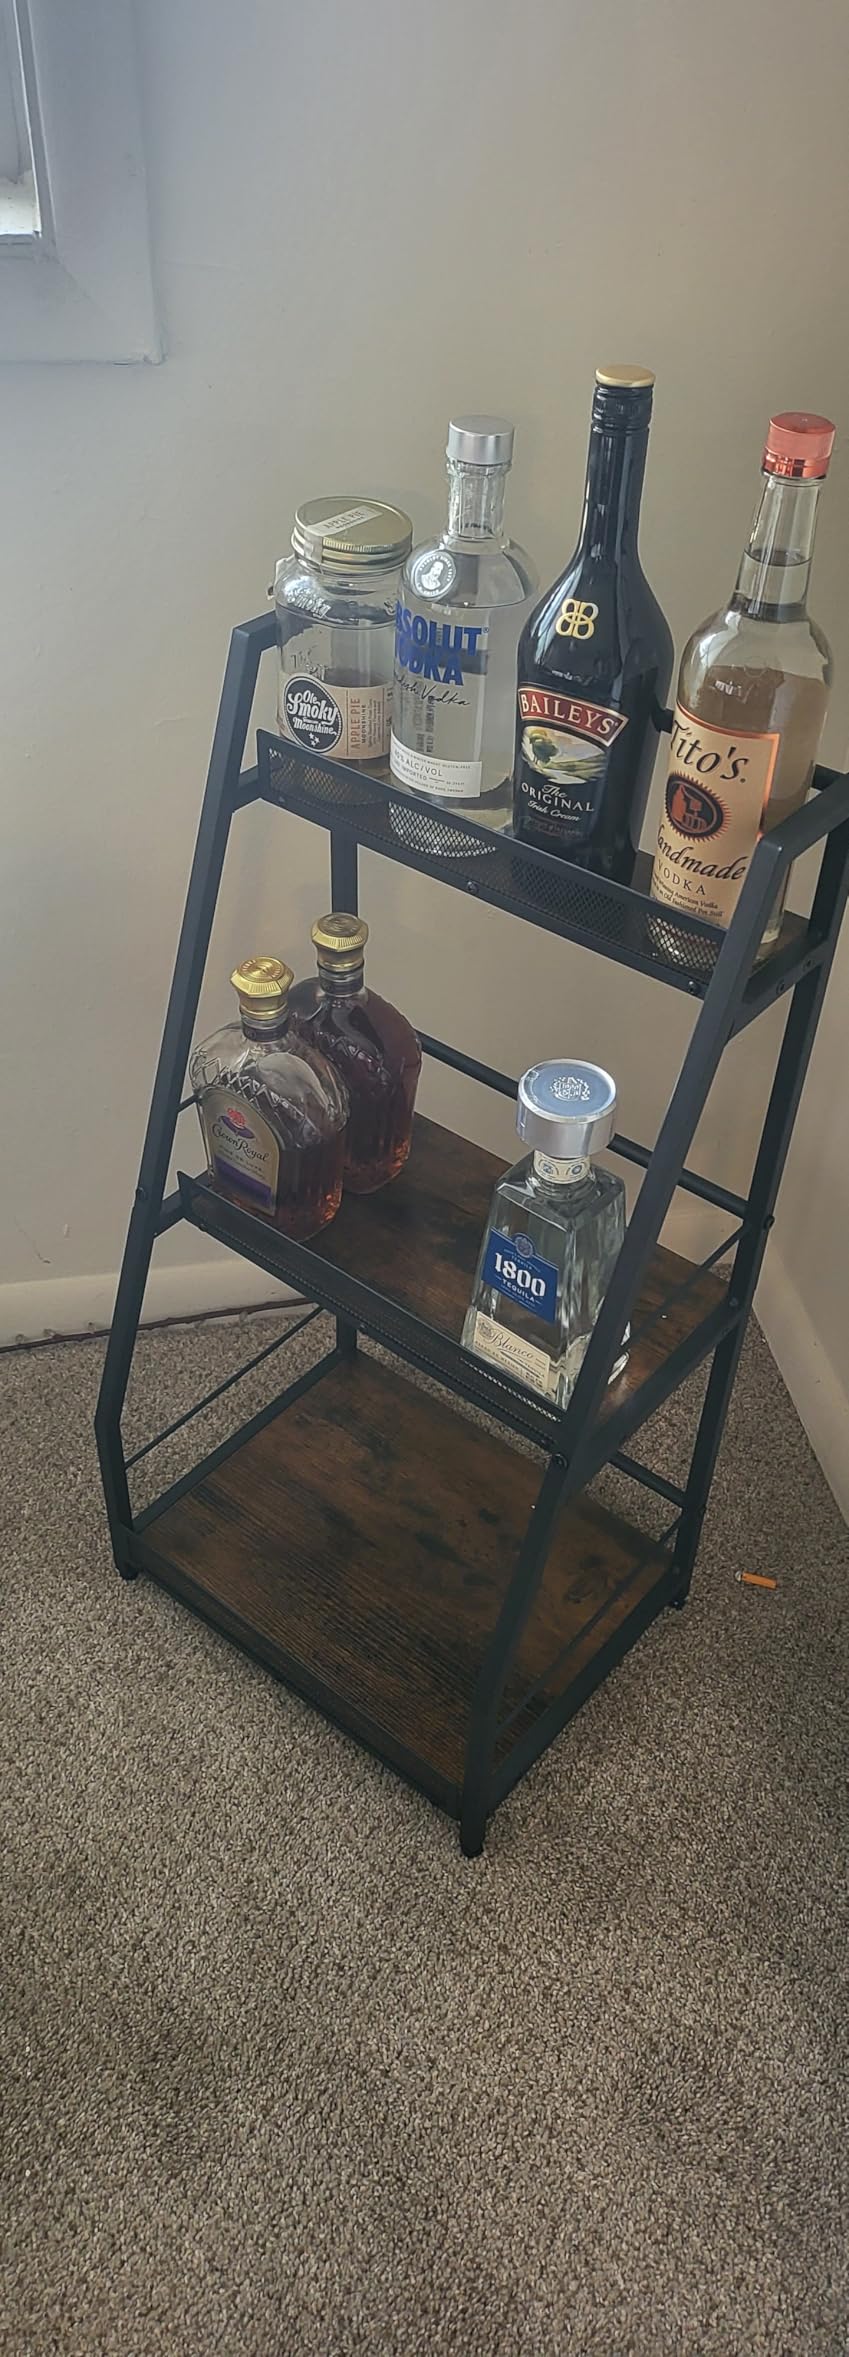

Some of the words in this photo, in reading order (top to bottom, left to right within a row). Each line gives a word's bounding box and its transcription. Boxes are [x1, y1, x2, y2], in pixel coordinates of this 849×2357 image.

[286, 692, 339, 726] Smoky
[303, 689, 321, 707] Ole
[350, 697, 361, 715] PIE
[421, 684, 470, 706] Vodka
[292, 716, 337, 736] Moonshine
[520, 693, 615, 735] BAILEYS
[350, 719, 361, 750] APPLE
[521, 782, 595, 813] ORIGINAL
[541, 784, 568, 799] The
[527, 800, 548, 814] Irish
[550, 809, 581, 822] Cream
[657, 858, 706, 896] VODKA
[212, 1122, 240, 1148] Crown
[237, 1139, 270, 1161] Royal
[494, 1252, 546, 1297] 1800
[501, 1278, 535, 1303] TEQUILA
[485, 1331, 534, 1359] Blanco
